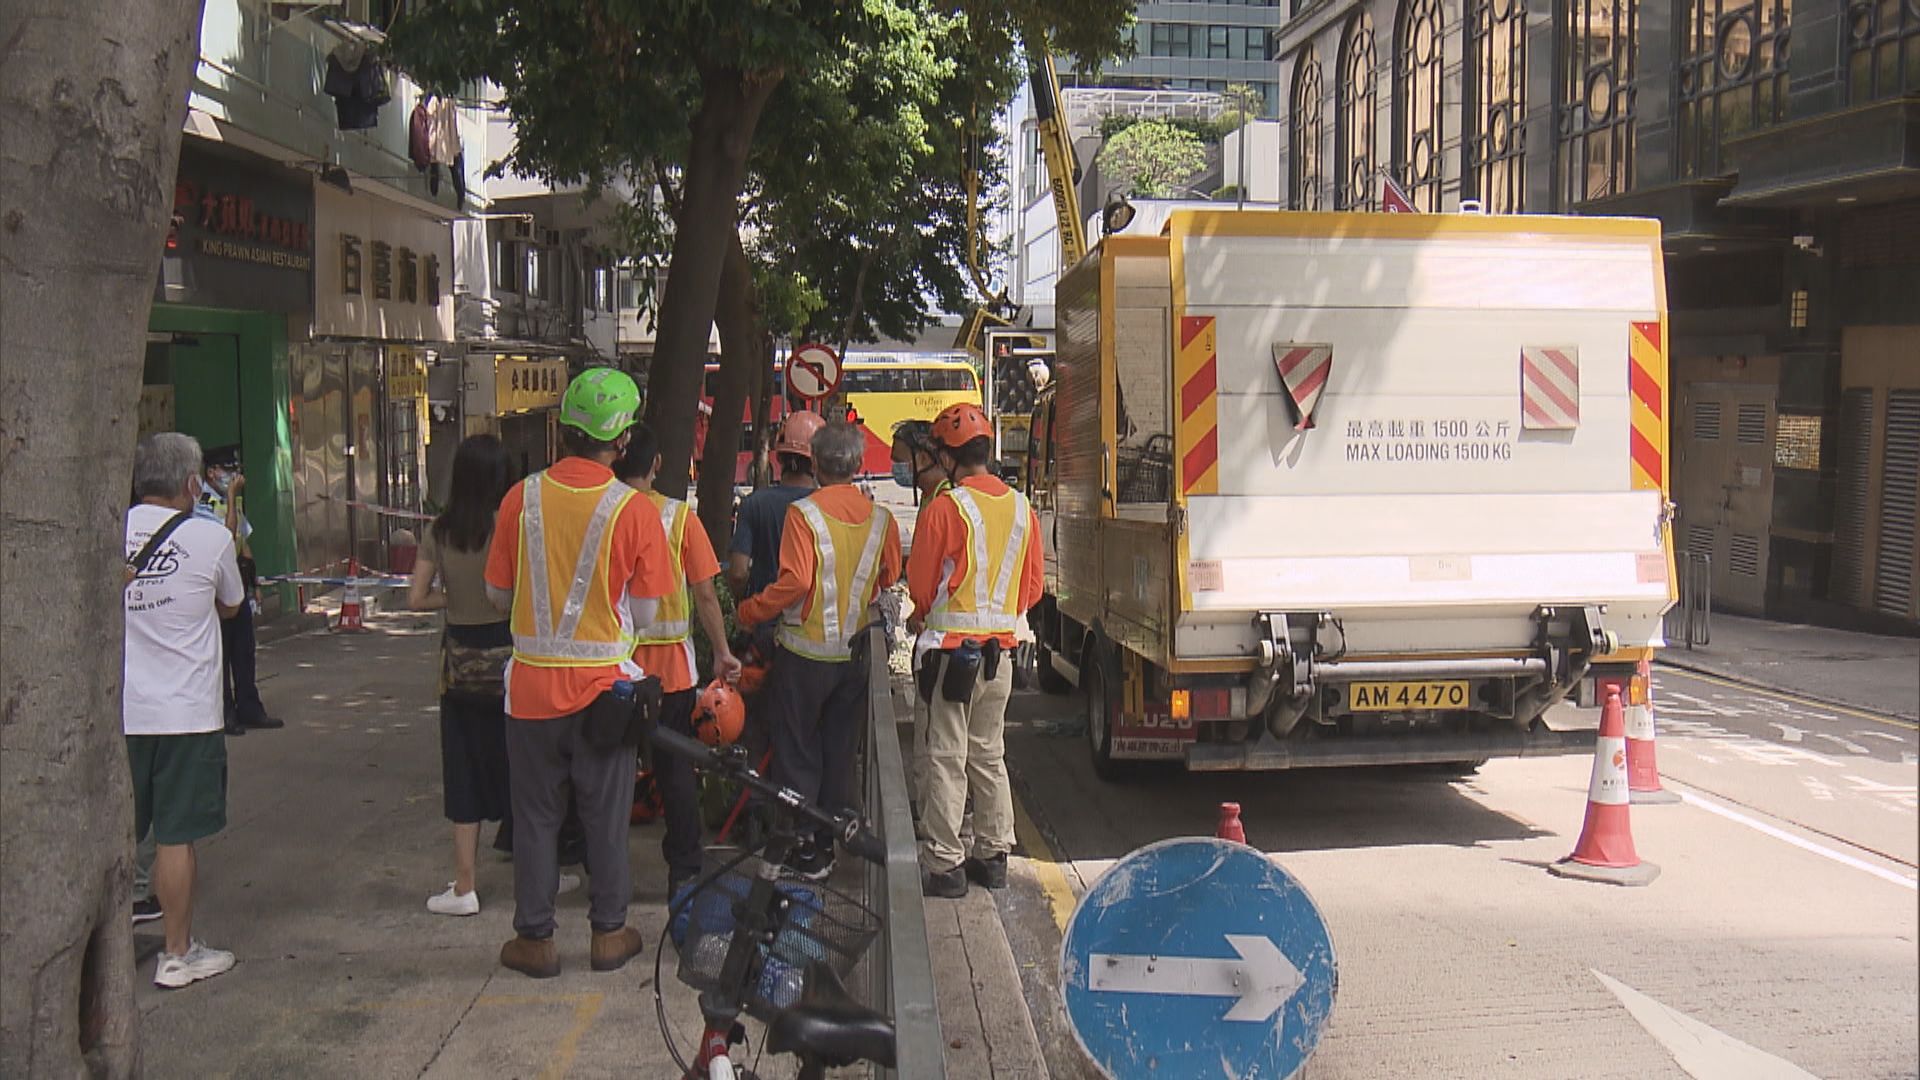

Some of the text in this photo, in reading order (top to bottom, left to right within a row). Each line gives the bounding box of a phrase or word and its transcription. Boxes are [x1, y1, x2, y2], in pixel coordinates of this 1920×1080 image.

[202, 239, 311, 271] KING PRAWN ASIAN RESTAURANT
[1433, 420, 1468, 437] 1500
[1475, 420, 1511, 437] 公斤
[1346, 443, 1511, 461] MAX LOADING 1500 KG
[1356, 685, 1463, 706] AM 4470
